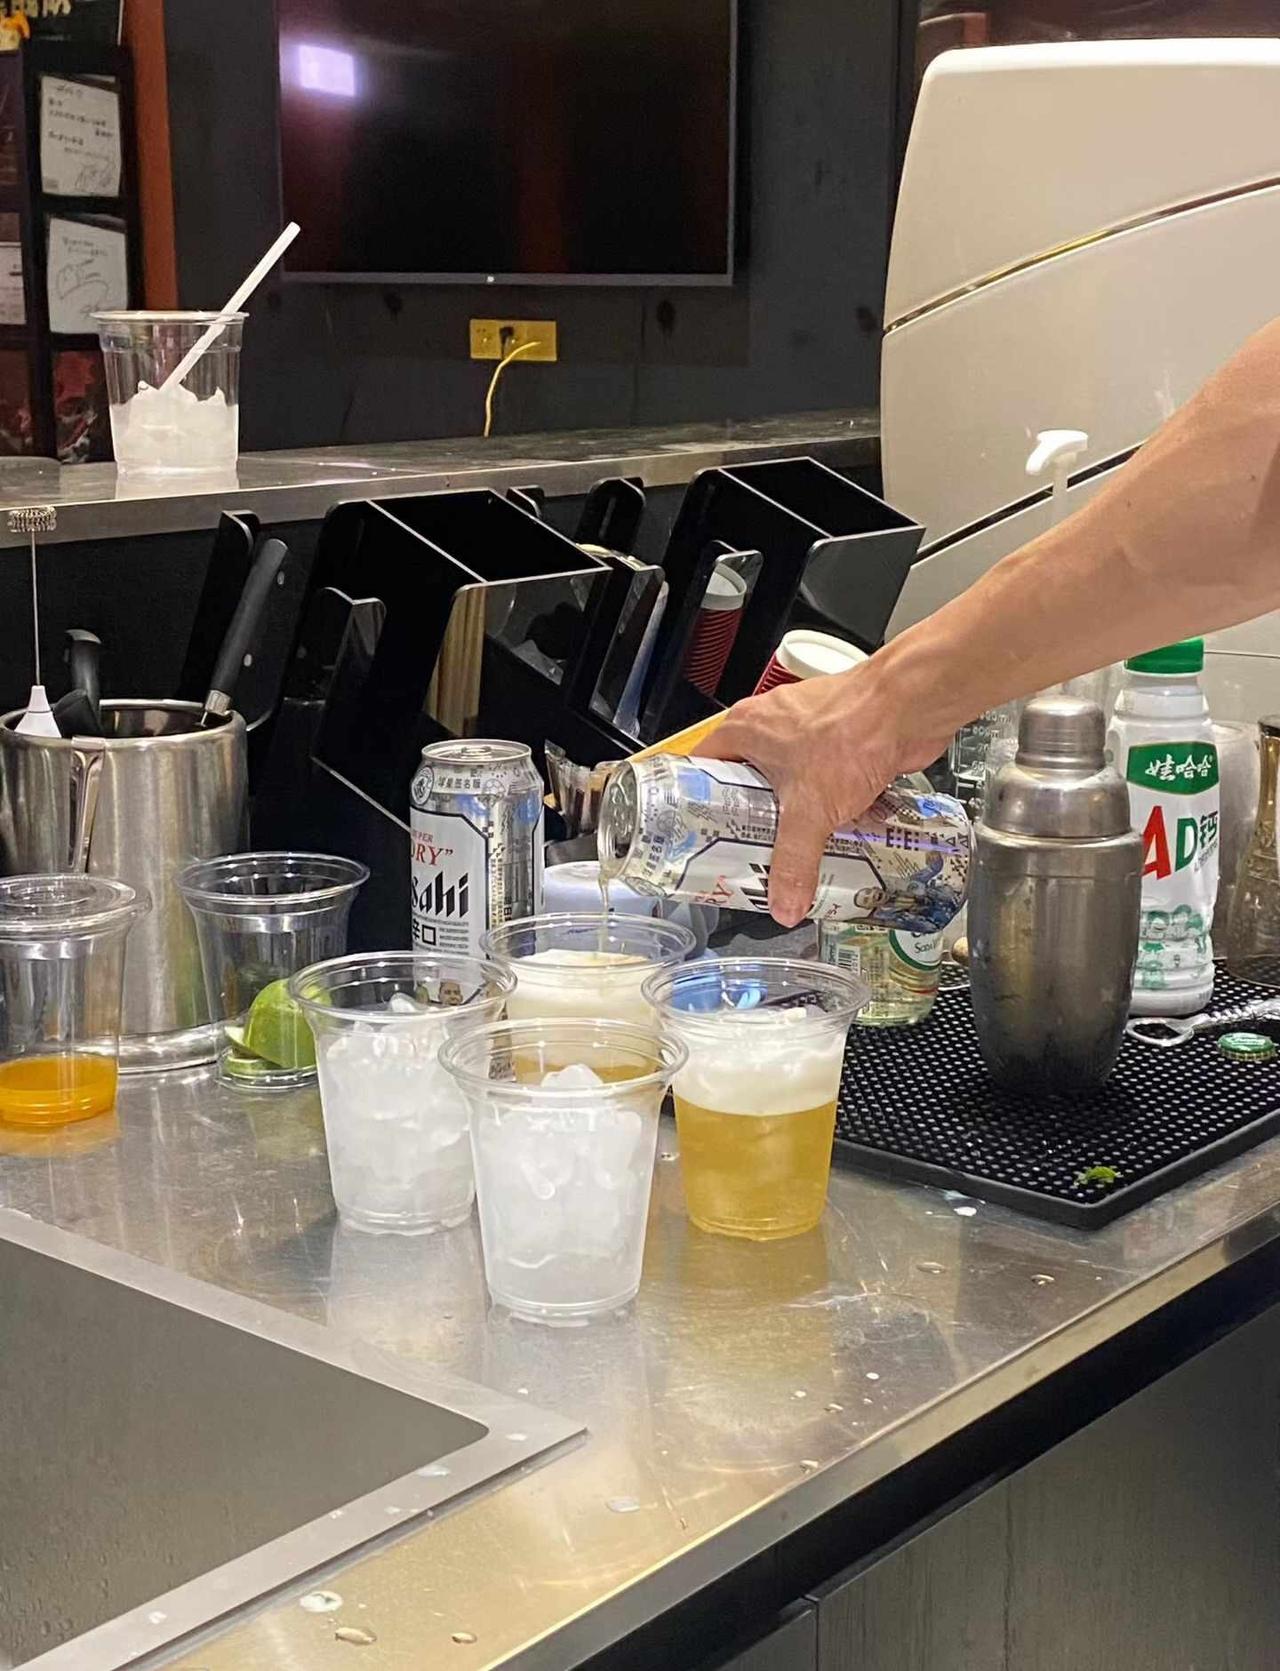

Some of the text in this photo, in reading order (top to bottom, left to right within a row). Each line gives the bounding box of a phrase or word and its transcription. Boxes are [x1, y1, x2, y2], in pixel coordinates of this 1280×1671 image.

[1144, 753, 1212, 781] 娃哈哈
[411, 871, 469, 918] sahi
